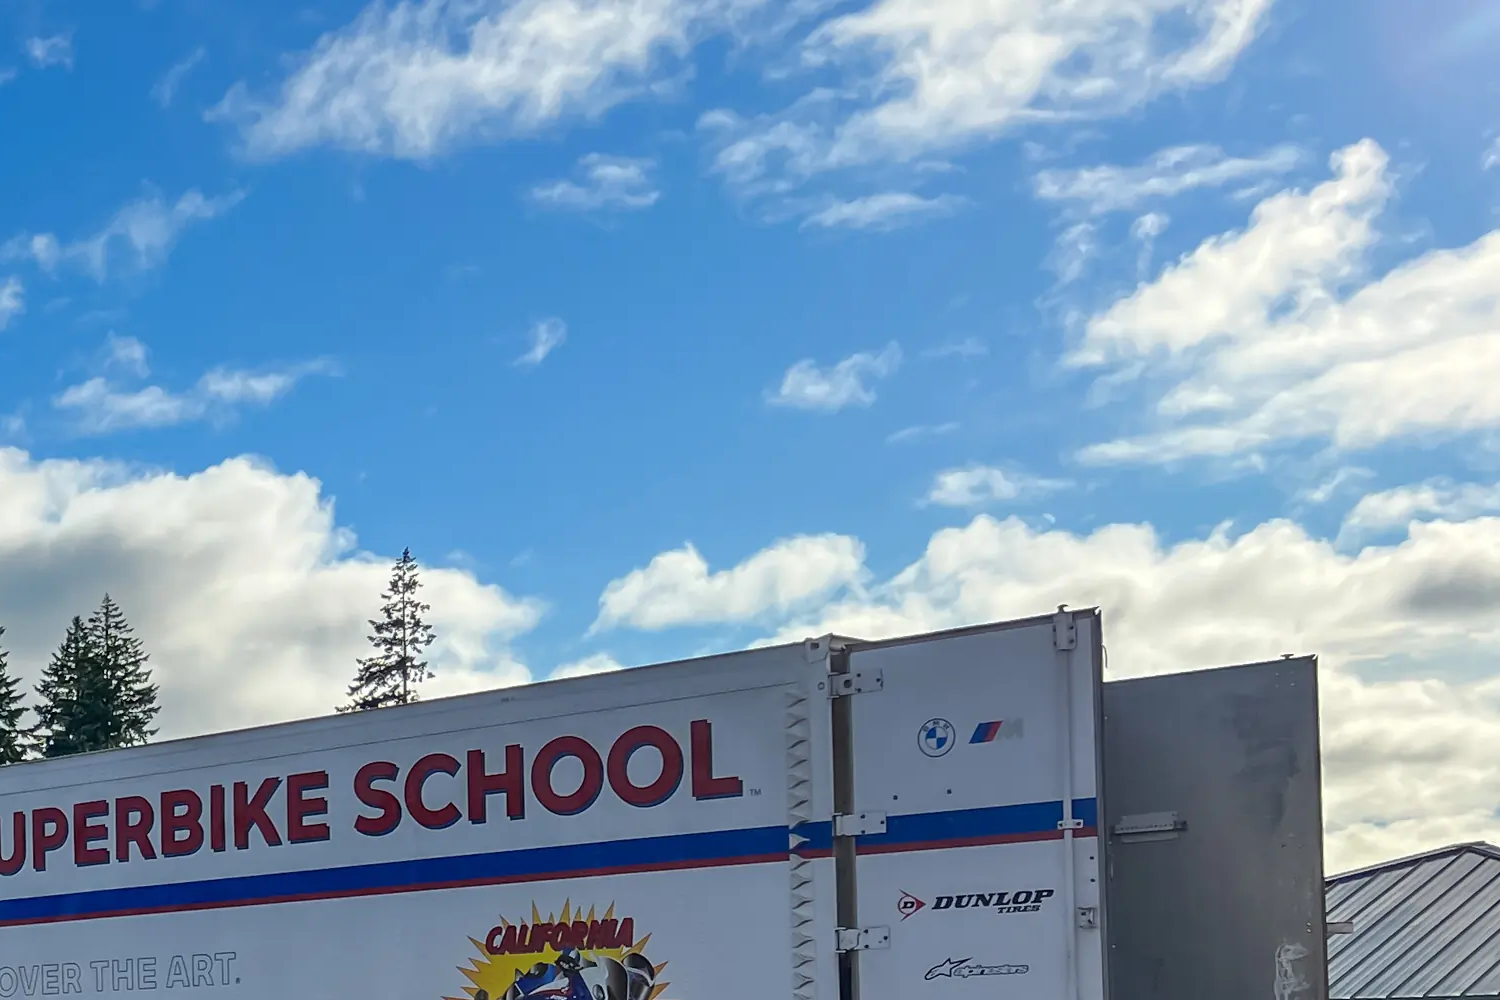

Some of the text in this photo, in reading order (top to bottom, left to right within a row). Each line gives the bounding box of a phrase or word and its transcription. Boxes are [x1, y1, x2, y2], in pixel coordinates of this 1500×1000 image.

[353, 719, 744, 837] SCHOOL
[931, 889, 1055, 910] DUNLOP
[997, 904, 1041, 914] TIRES
[485, 916, 635, 955] CALIFORNIA
[90, 957, 157, 992] THE
[166, 951, 241, 989] ART.
